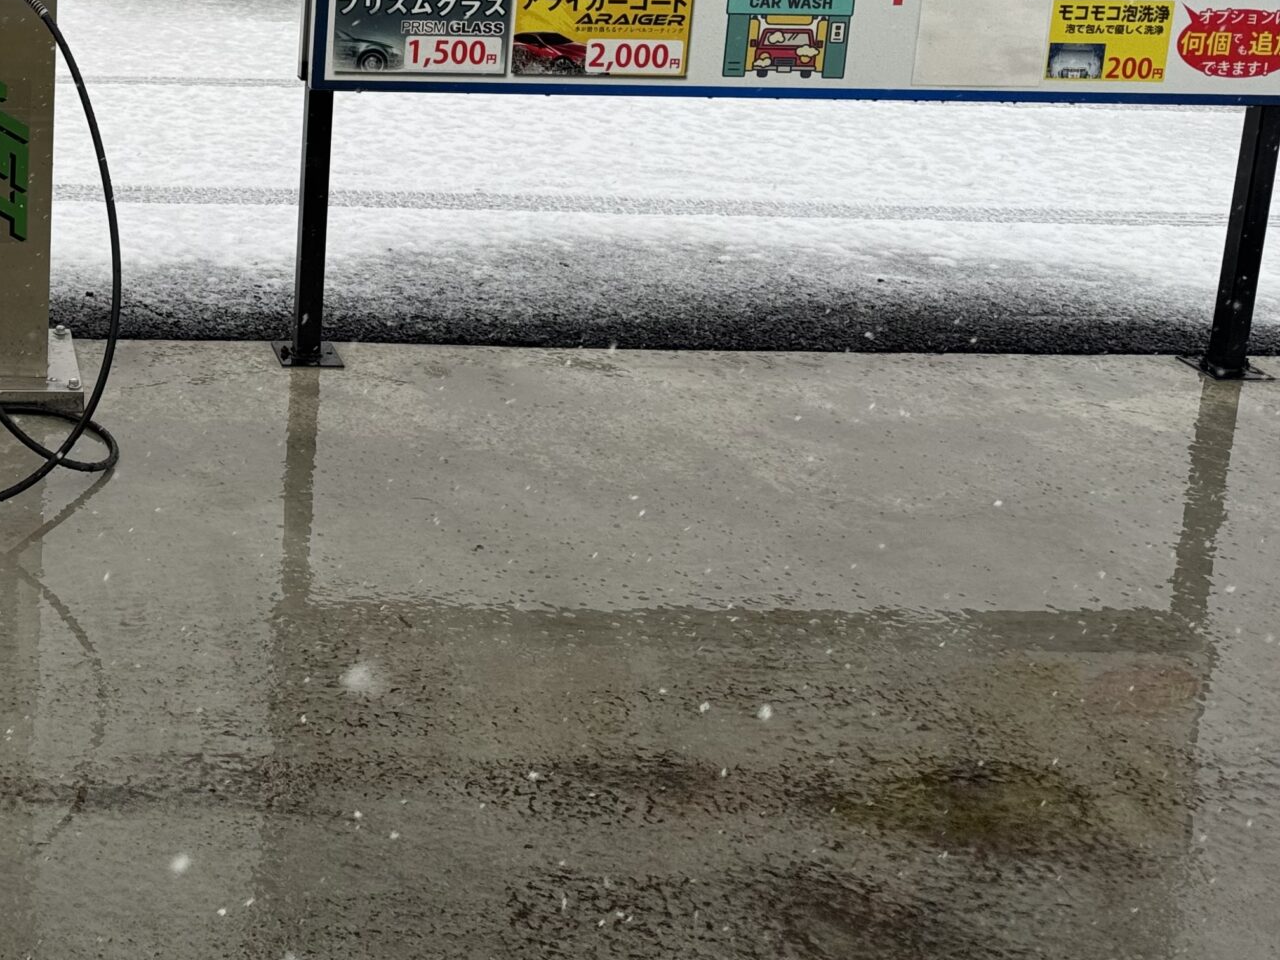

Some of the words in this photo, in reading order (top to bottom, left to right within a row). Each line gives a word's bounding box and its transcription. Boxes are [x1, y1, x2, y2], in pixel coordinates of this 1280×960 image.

[575, 13, 686, 26] ARAIGER
[1058, 4, 1171, 23] モコモコ泡洗浄
[401, 20, 446, 34] PRISM
[449, 21, 505, 35] GLASS
[1064, 24, 1164, 35] 泡で包んで優しく洗浄
[409, 39, 497, 68] 1,500円
[588, 42, 680, 71] 2,000円
[1105, 57, 1164, 80] 200円
